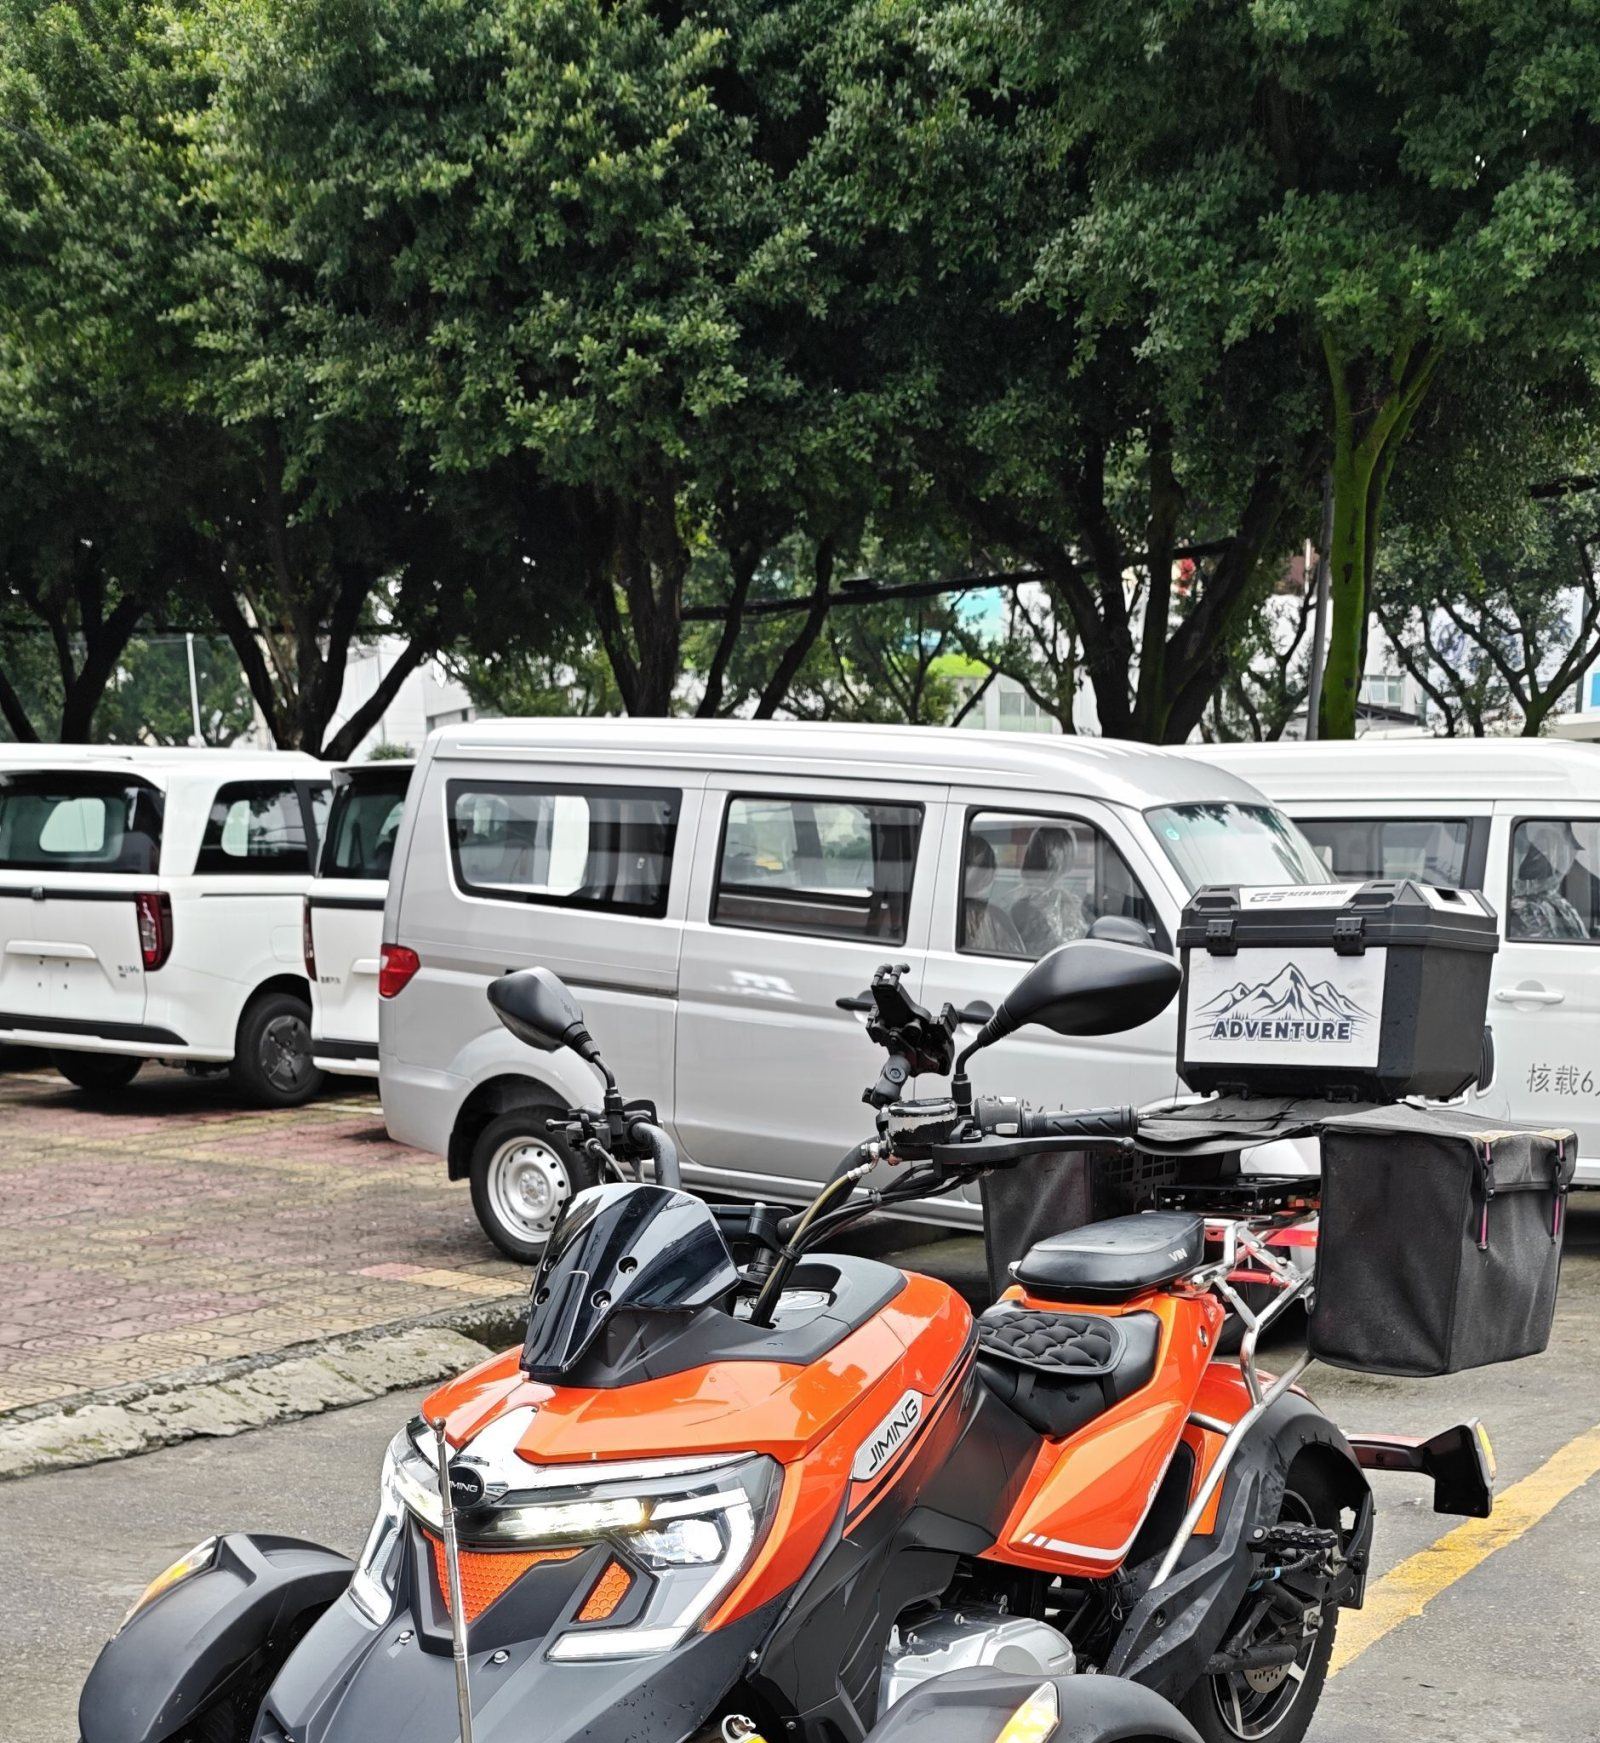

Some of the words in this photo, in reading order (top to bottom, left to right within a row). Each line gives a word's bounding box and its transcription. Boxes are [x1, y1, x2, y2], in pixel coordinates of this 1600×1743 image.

[1212, 1020, 1351, 1040] ADVENTURE
[1526, 1063, 1600, 1097] 核载6
[869, 1398, 918, 1472] JIMING
[449, 1480, 479, 1493] MING
